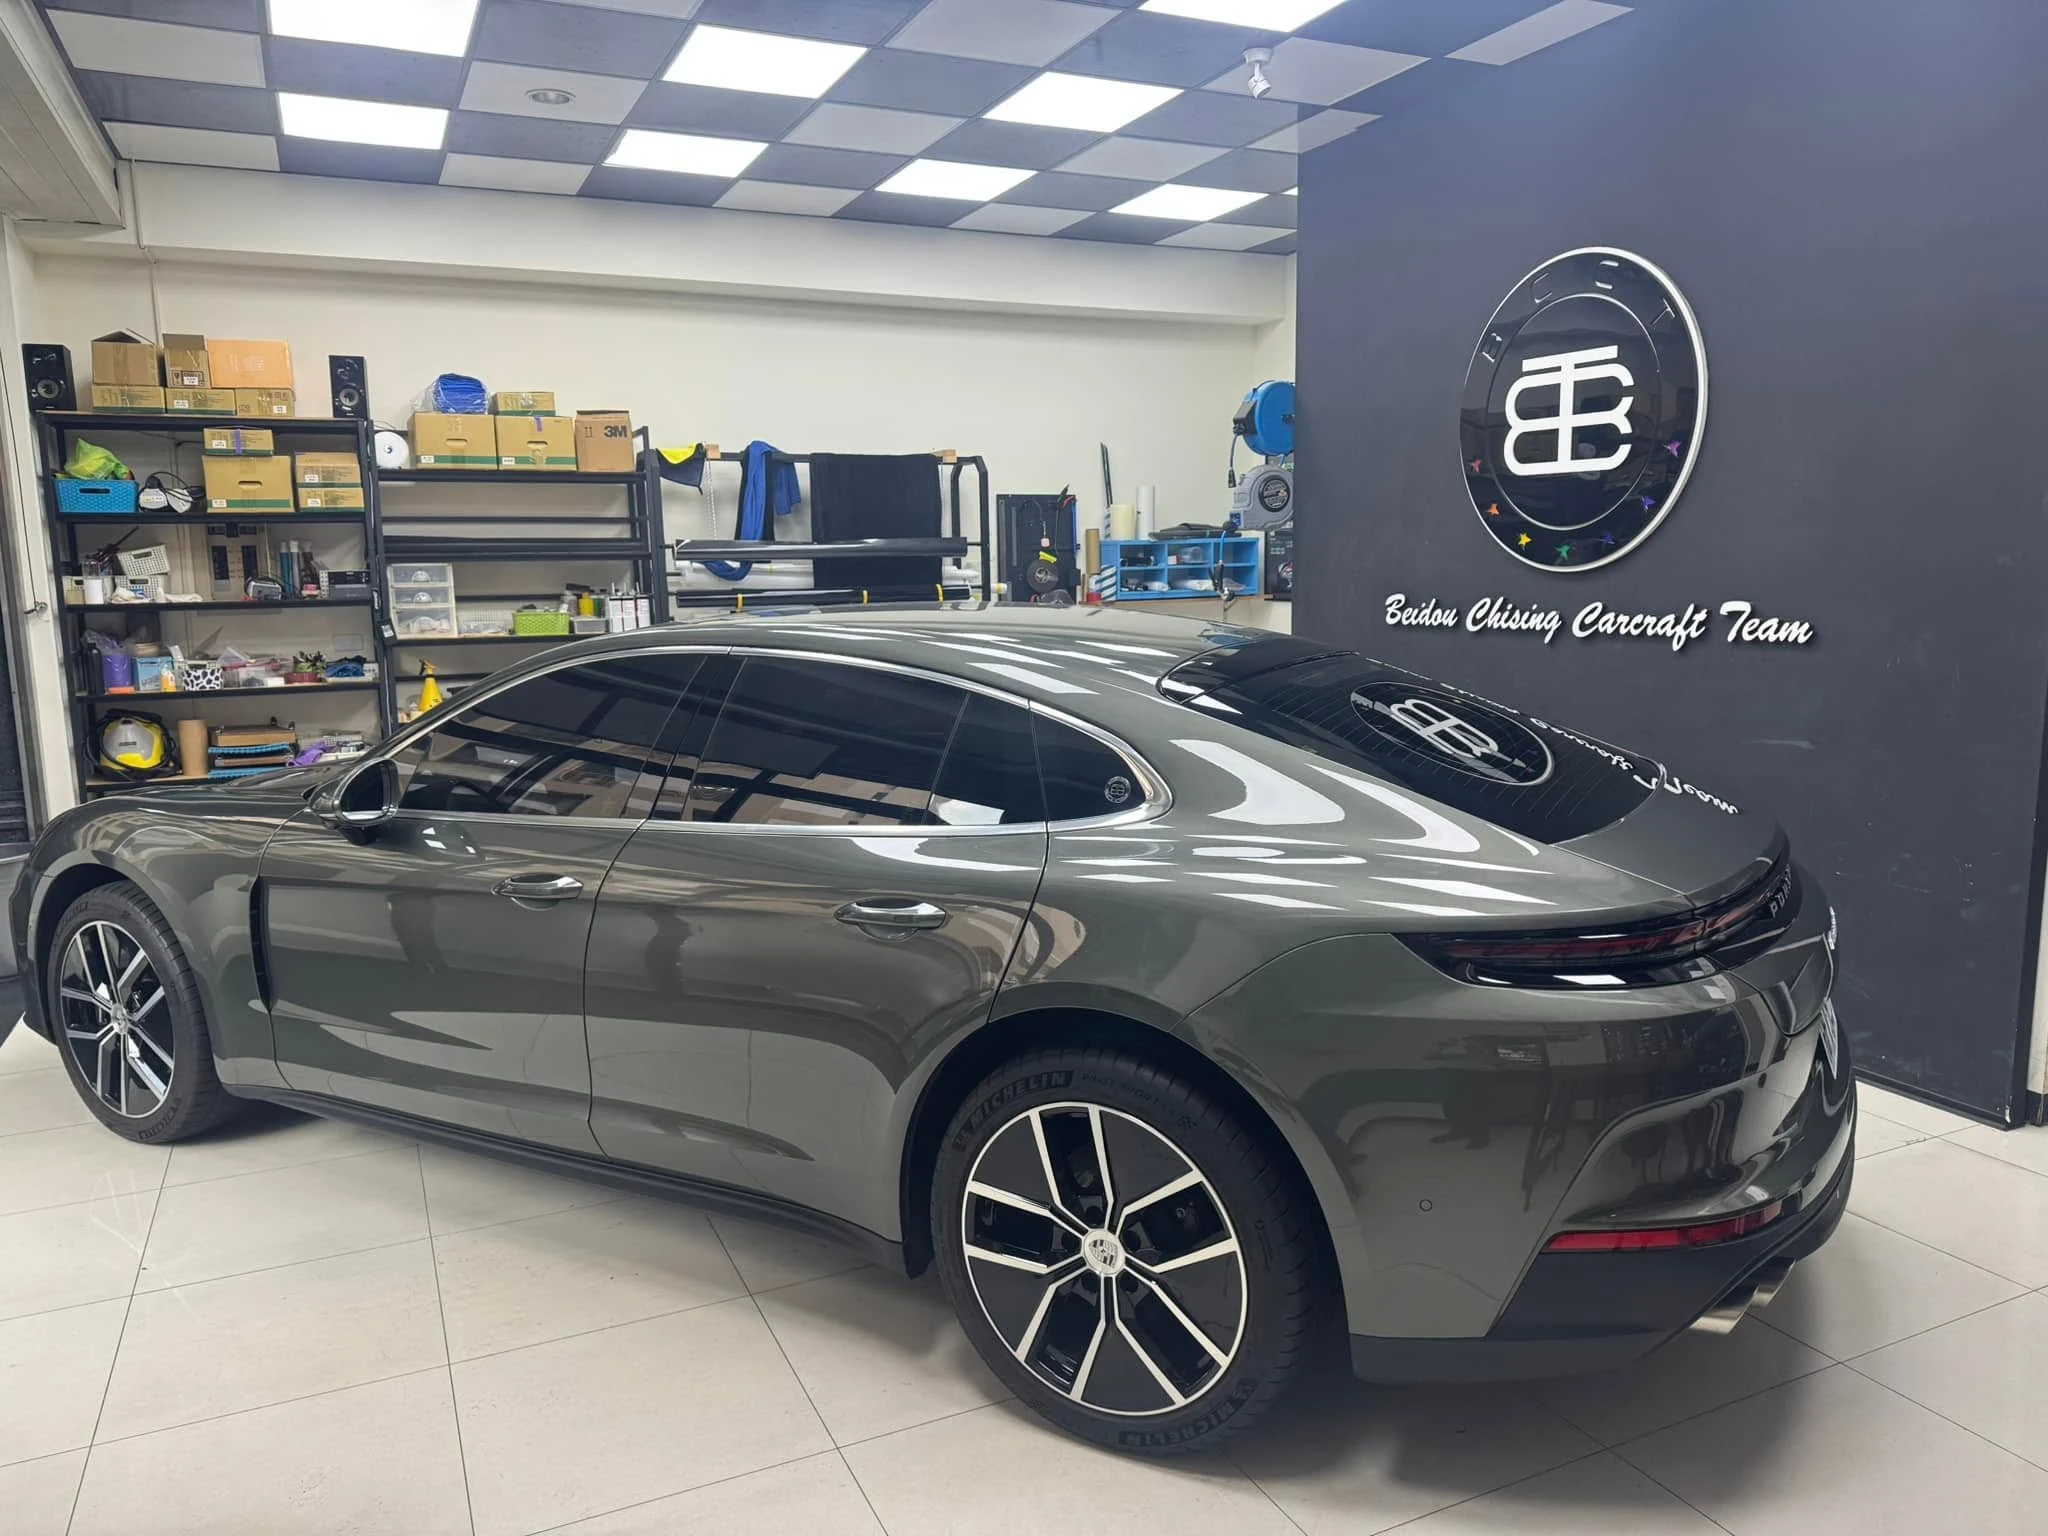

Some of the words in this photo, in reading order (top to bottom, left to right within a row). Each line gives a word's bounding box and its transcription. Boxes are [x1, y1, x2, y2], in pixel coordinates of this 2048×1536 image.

[603, 424, 628, 438] 3M
[1385, 593, 1459, 627] Beidou
[1465, 596, 1562, 644] Chising
[1571, 601, 1708, 651] Carcraft
[1719, 600, 1814, 644] Team
[966, 1071, 1068, 1129] MICHELIN
